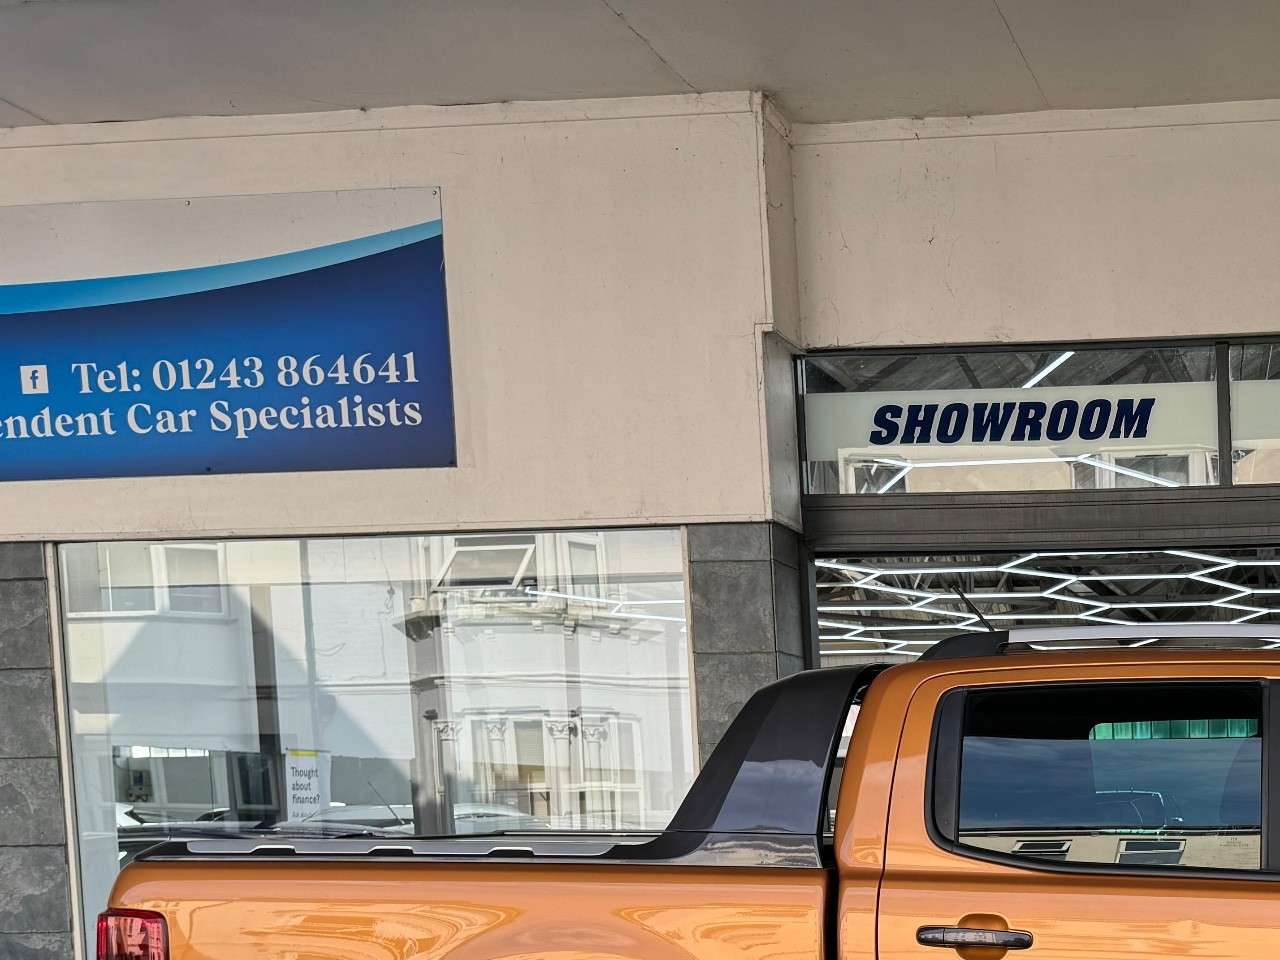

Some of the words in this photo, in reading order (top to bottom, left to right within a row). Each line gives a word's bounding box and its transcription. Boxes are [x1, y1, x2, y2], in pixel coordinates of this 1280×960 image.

[72, 361, 141, 394] Tel:
[152, 356, 265, 391] 01243
[277, 351, 419, 387] 864641
[0, 406, 117, 439] ndent
[127, 402, 197, 434] Car
[209, 394, 423, 439] Specialists
[868, 397, 1156, 446] SHOWROOM
[291, 780, 312, 791] about
